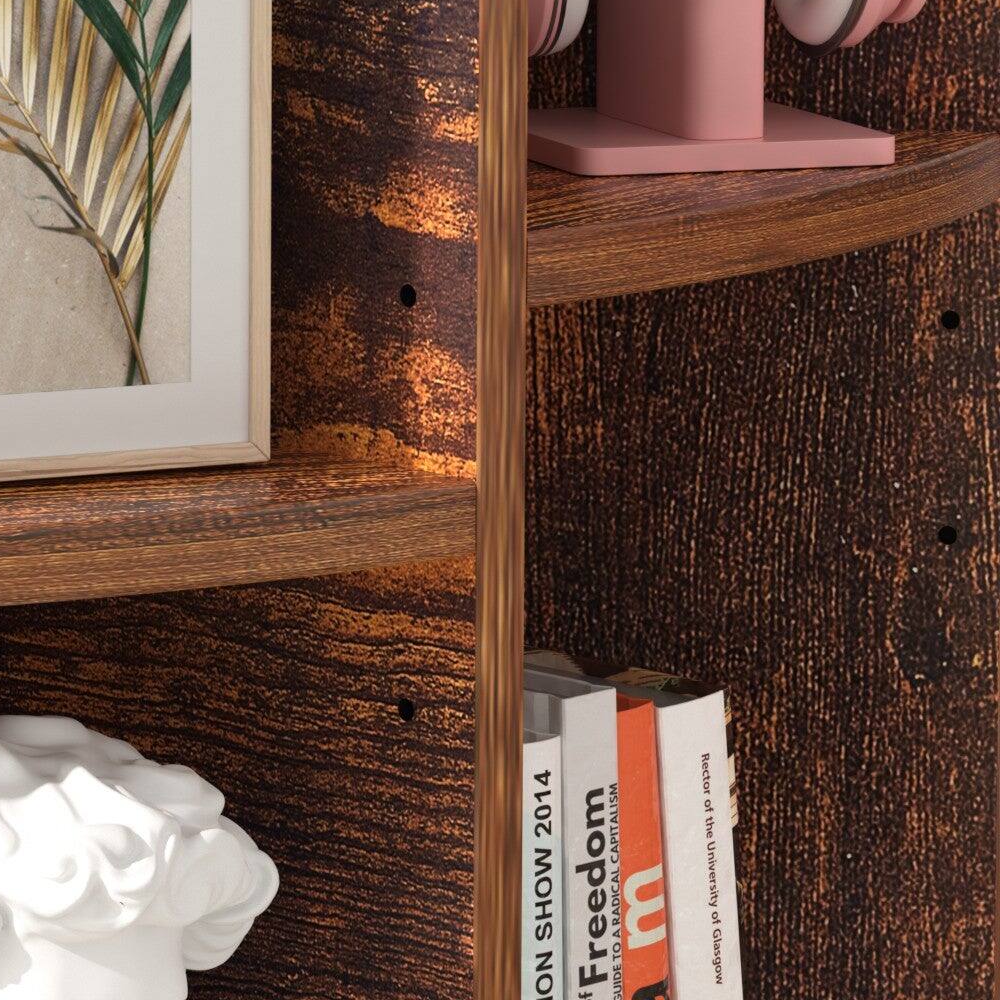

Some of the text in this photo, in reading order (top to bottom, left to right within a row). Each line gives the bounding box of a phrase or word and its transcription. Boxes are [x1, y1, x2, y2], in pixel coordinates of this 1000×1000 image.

[534, 770, 552, 837] 2014
[608, 783, 620, 864] CAPITALISM
[535, 848, 553, 941] SHOW
[575, 787, 608, 987] Freedom
[610, 866, 621, 926] RADICAL
[702, 753, 722, 985] Rector of the University of Glasgow
[612, 931, 621, 940] A
[612, 942, 621, 961] TO
